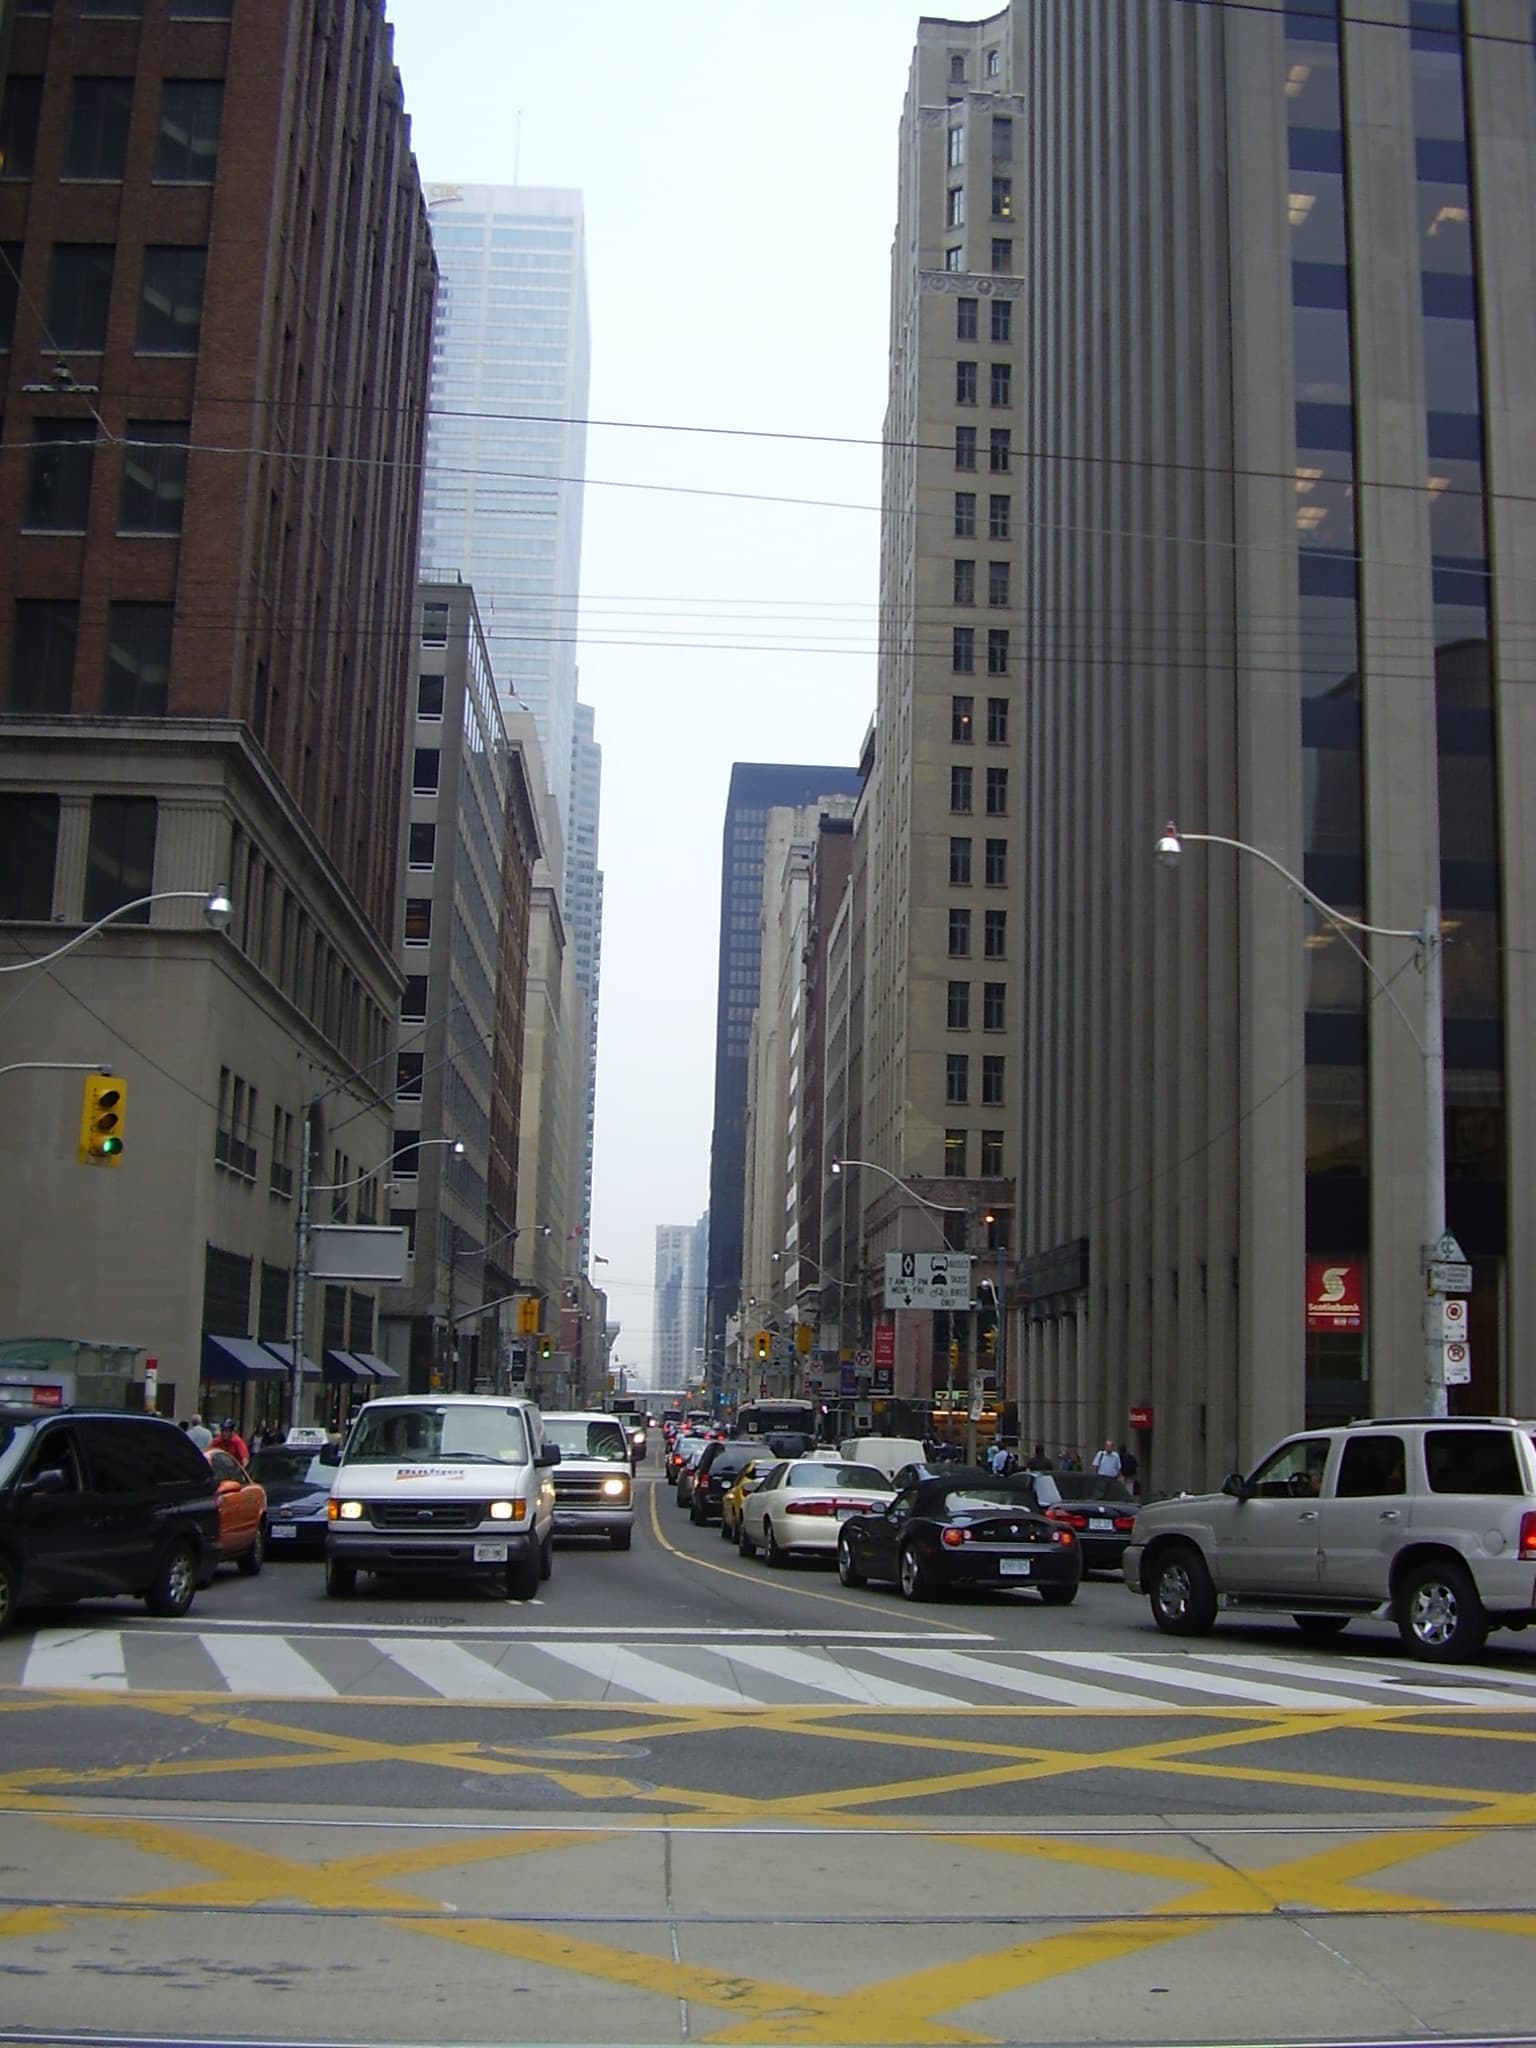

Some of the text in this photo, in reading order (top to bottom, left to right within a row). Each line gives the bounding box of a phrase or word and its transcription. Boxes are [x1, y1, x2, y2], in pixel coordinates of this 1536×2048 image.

[431, 185, 464, 197] CIBC
[1308, 1303, 1360, 1312] Scotiabank
[397, 1468, 465, 1476] Budget
